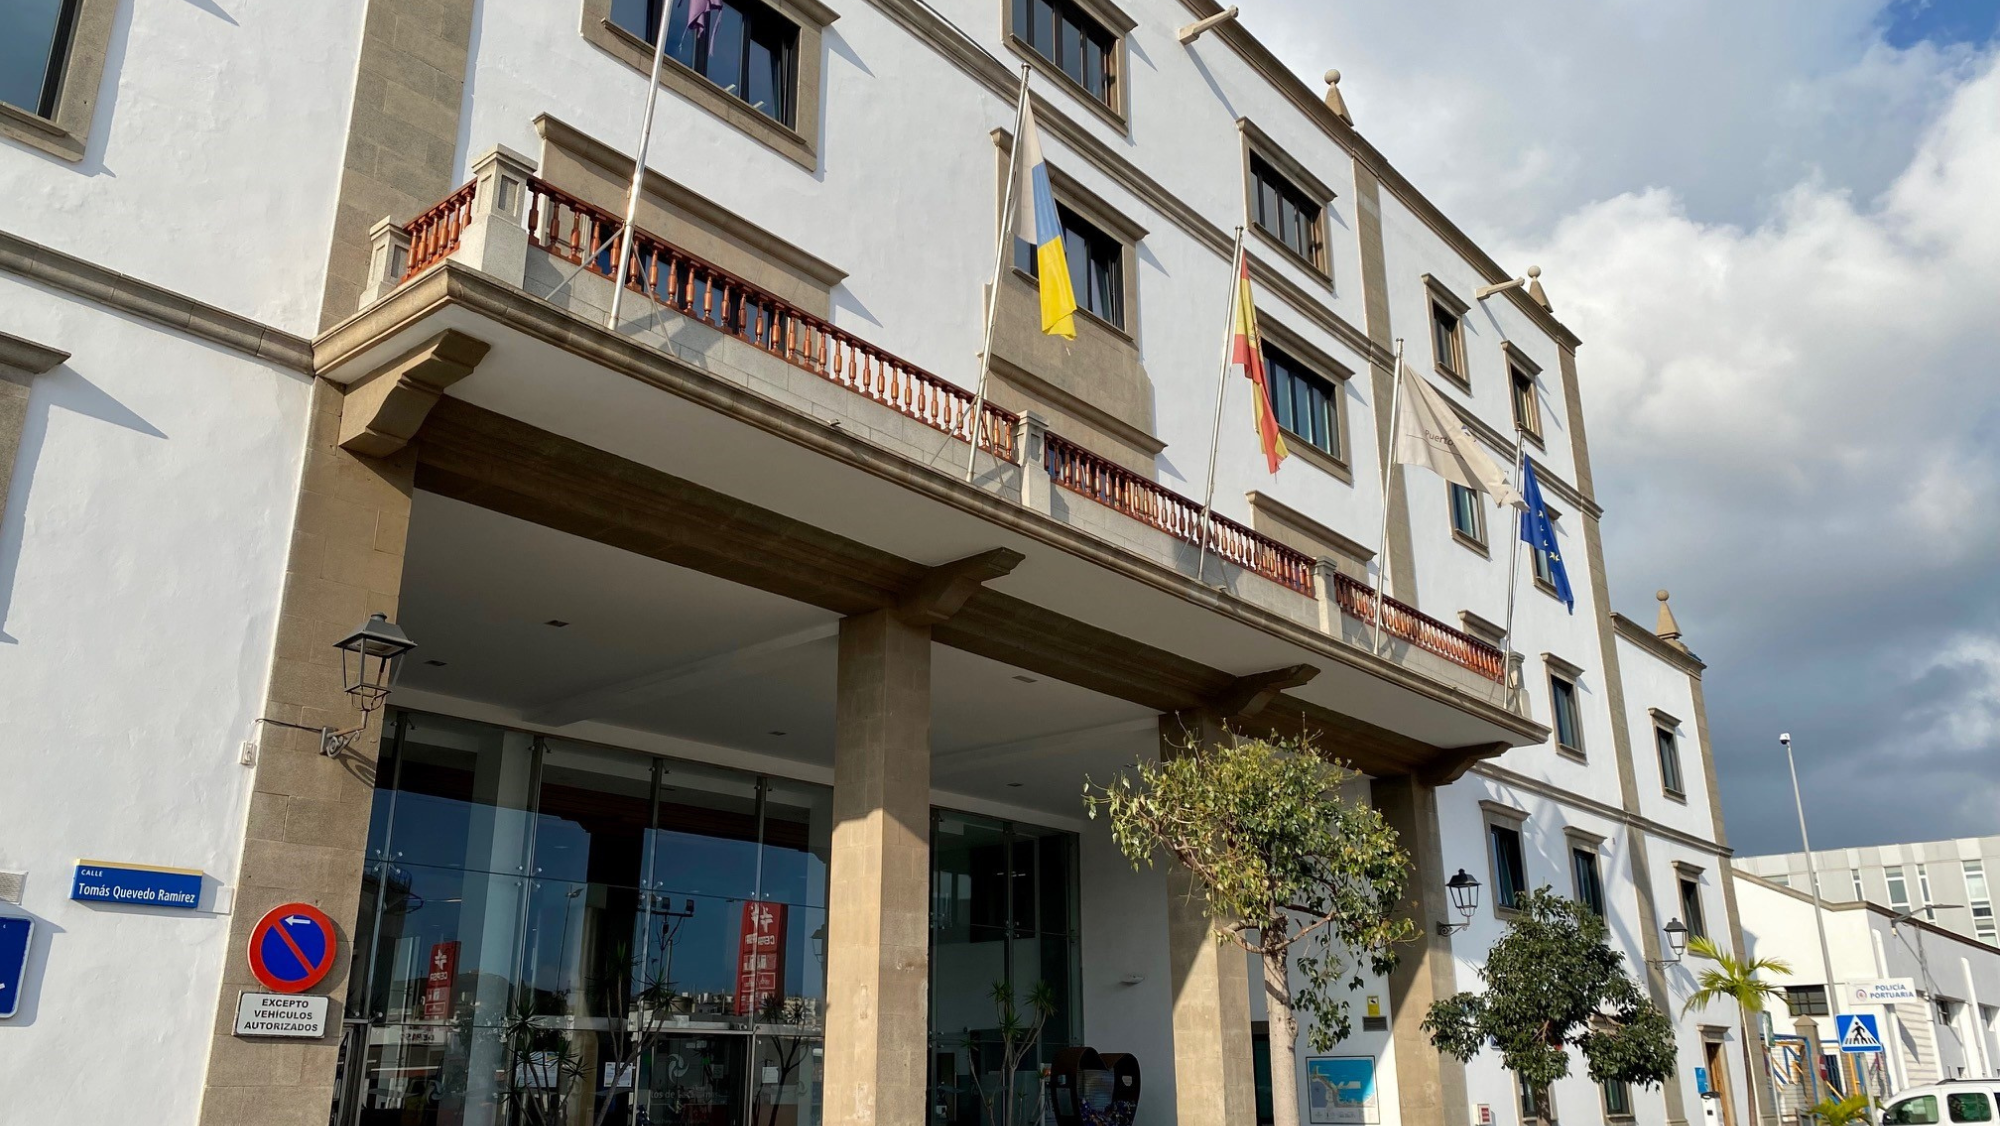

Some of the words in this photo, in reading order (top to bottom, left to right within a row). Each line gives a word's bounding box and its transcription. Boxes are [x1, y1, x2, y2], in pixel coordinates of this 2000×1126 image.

[1425, 429, 1455, 447] Puerto
[80, 869, 103, 878] CALLE
[78, 882, 111, 897] Tomás
[112, 885, 156, 900] Quevedo
[157, 889, 196, 903] Ramírez
[1875, 983, 1906, 991] POLICÍA
[1870, 991, 1914, 999] PORTUARIA
[261, 998, 309, 1009] EXCEPTO
[254, 1009, 313, 1020] VEHÍCULOS
[243, 1021, 318, 1032] AUTORIZADOS
